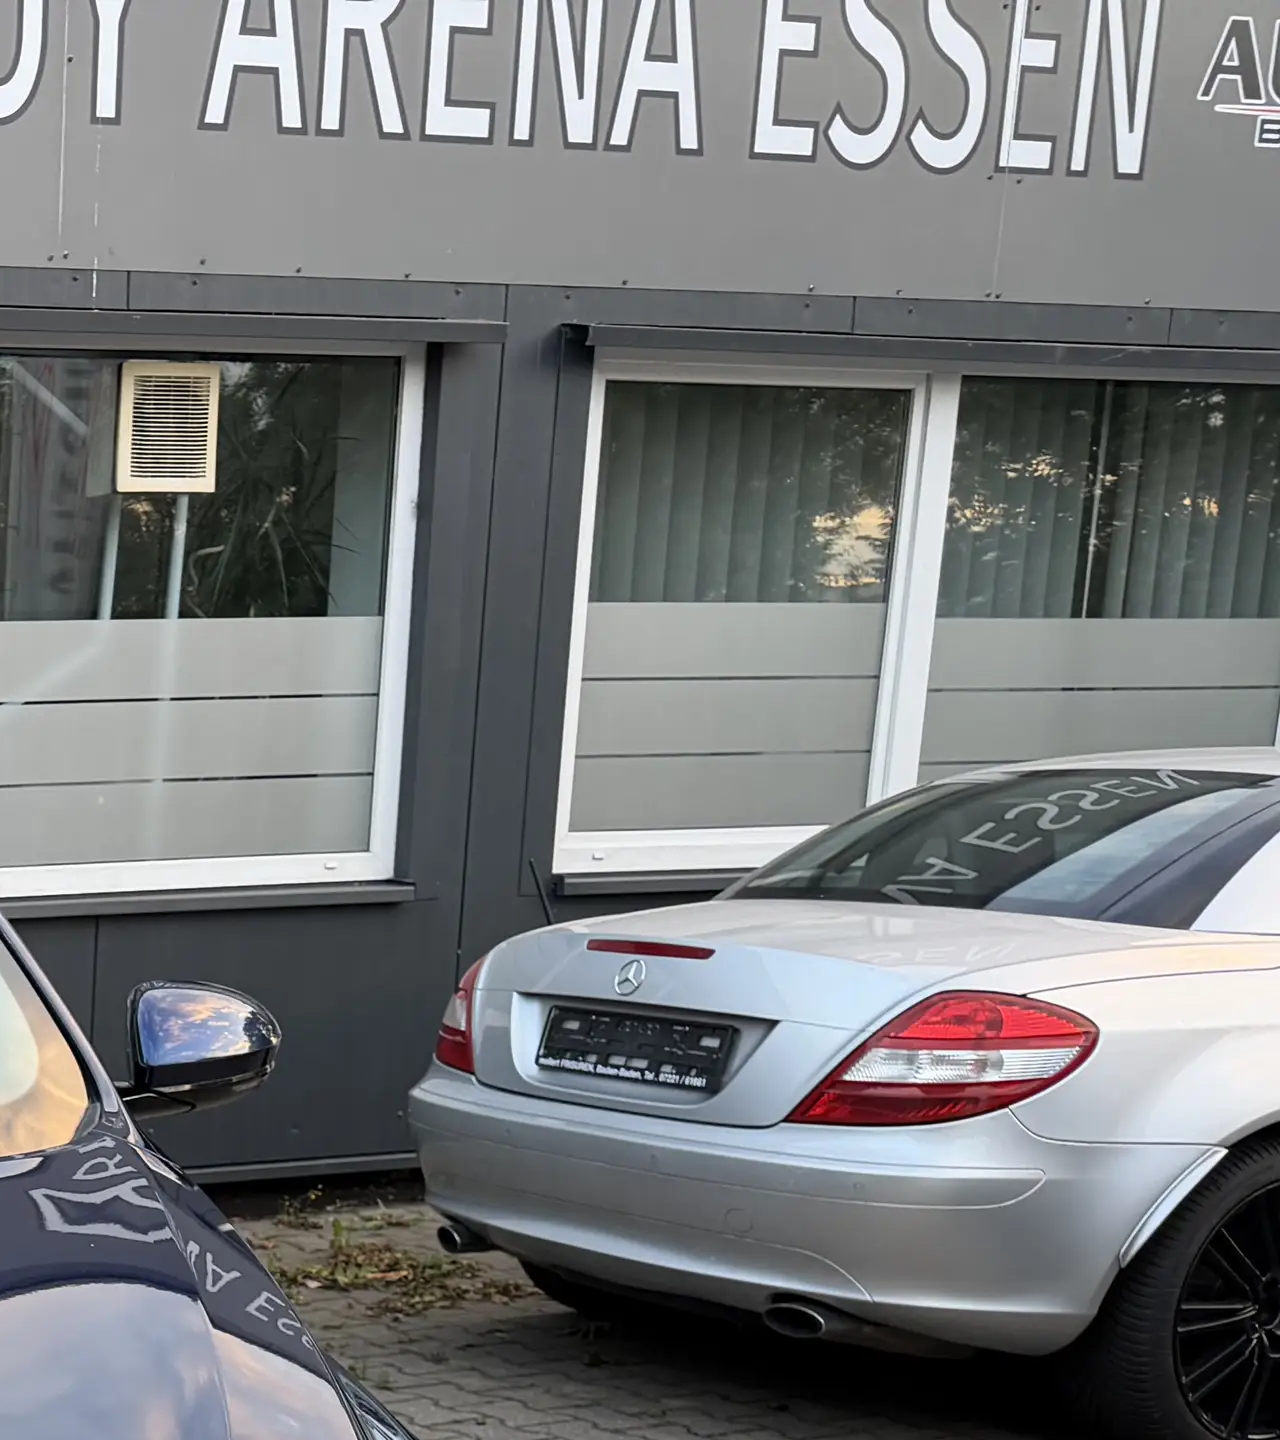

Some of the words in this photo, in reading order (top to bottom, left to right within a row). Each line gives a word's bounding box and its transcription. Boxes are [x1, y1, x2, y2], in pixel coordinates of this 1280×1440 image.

[197, 0, 704, 157] ARENA
[748, 0, 1163, 180] ESSEN
[1197, 16, 1280, 104] A
